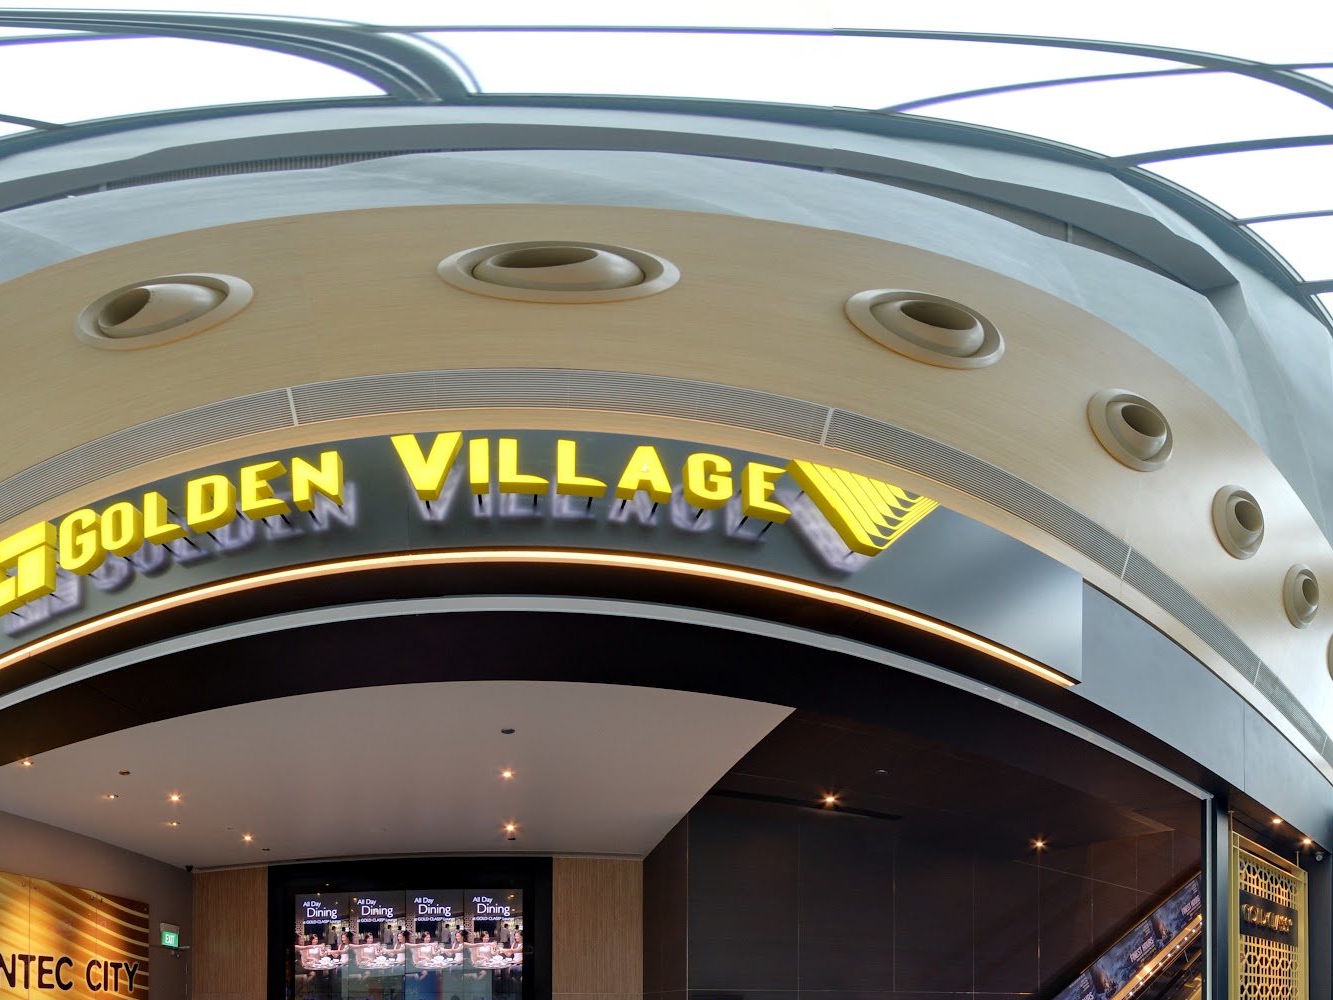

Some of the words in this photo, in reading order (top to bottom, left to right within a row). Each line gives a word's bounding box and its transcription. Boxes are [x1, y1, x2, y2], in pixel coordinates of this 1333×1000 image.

[59, 451, 344, 576] GOLDEN
[390, 431, 792, 524] VILLAGE
[423, 897, 434, 905] Day
[307, 907, 337, 919] Dining
[362, 905, 393, 917] Dining
[418, 904, 451, 917] Dining
[477, 903, 510, 916] Dining
[165, 933, 175, 945] EXIT
[1130, 946, 1143, 962] FINEST
[1142, 937, 1154, 954] HOURS
[85, 959, 139, 992] CITY
